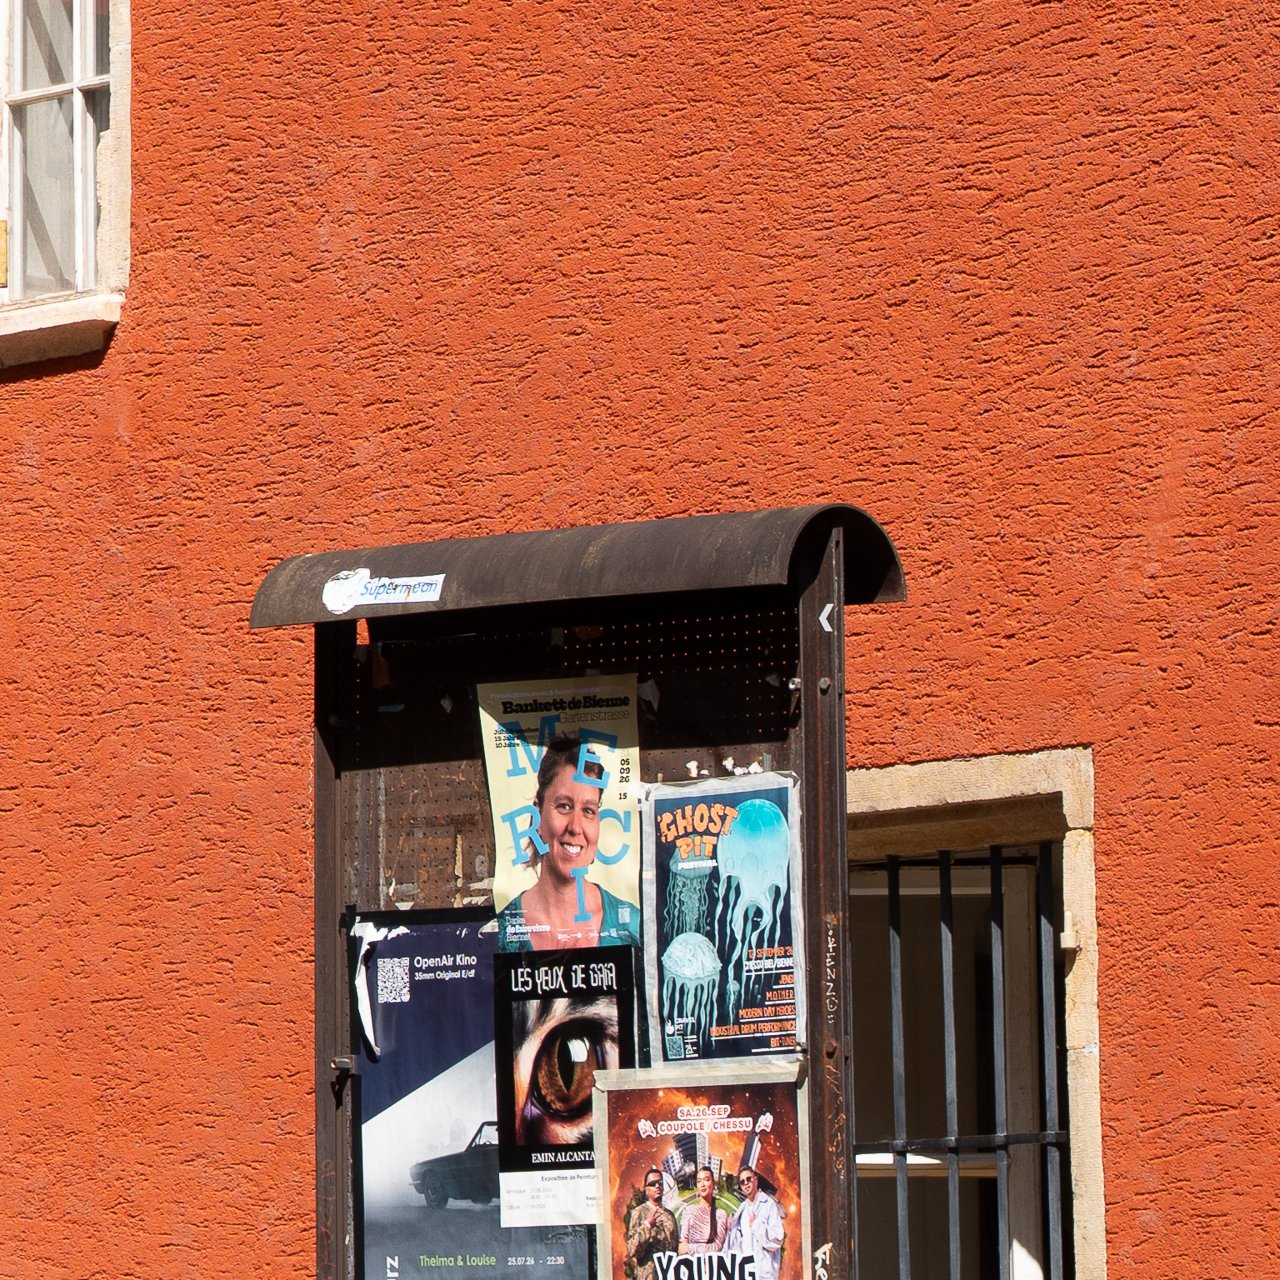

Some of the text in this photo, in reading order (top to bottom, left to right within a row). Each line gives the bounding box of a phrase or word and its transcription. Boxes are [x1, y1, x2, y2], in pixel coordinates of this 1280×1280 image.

[501, 695, 630, 714] Bankett de Bienne
[620, 758, 630, 766] 05
[658, 803, 739, 843] GHOST
[675, 835, 718, 860] PIT
[678, 859, 718, 870] FESTIVAL
[414, 954, 477, 969] OpenAir Kino
[414, 971, 435, 980] 35mm
[435, 969, 460, 981] Original
[511, 967, 532, 992] LES
[535, 966, 568, 994] YEUX
[571, 964, 587, 989] DE
[758, 1020, 795, 1032] PERFORMANCE
[659, 1122, 705, 1132] COUPOLE
[713, 1119, 751, 1130] CHESSU
[531, 1152, 555, 1163] EMIN
[420, 1255, 454, 1267] Thelma
[456, 1255, 464, 1266] &
[466, 1254, 496, 1266] Louise
[508, 1257, 535, 1266] 25.07.26
[546, 1256, 565, 1265] 22:30
